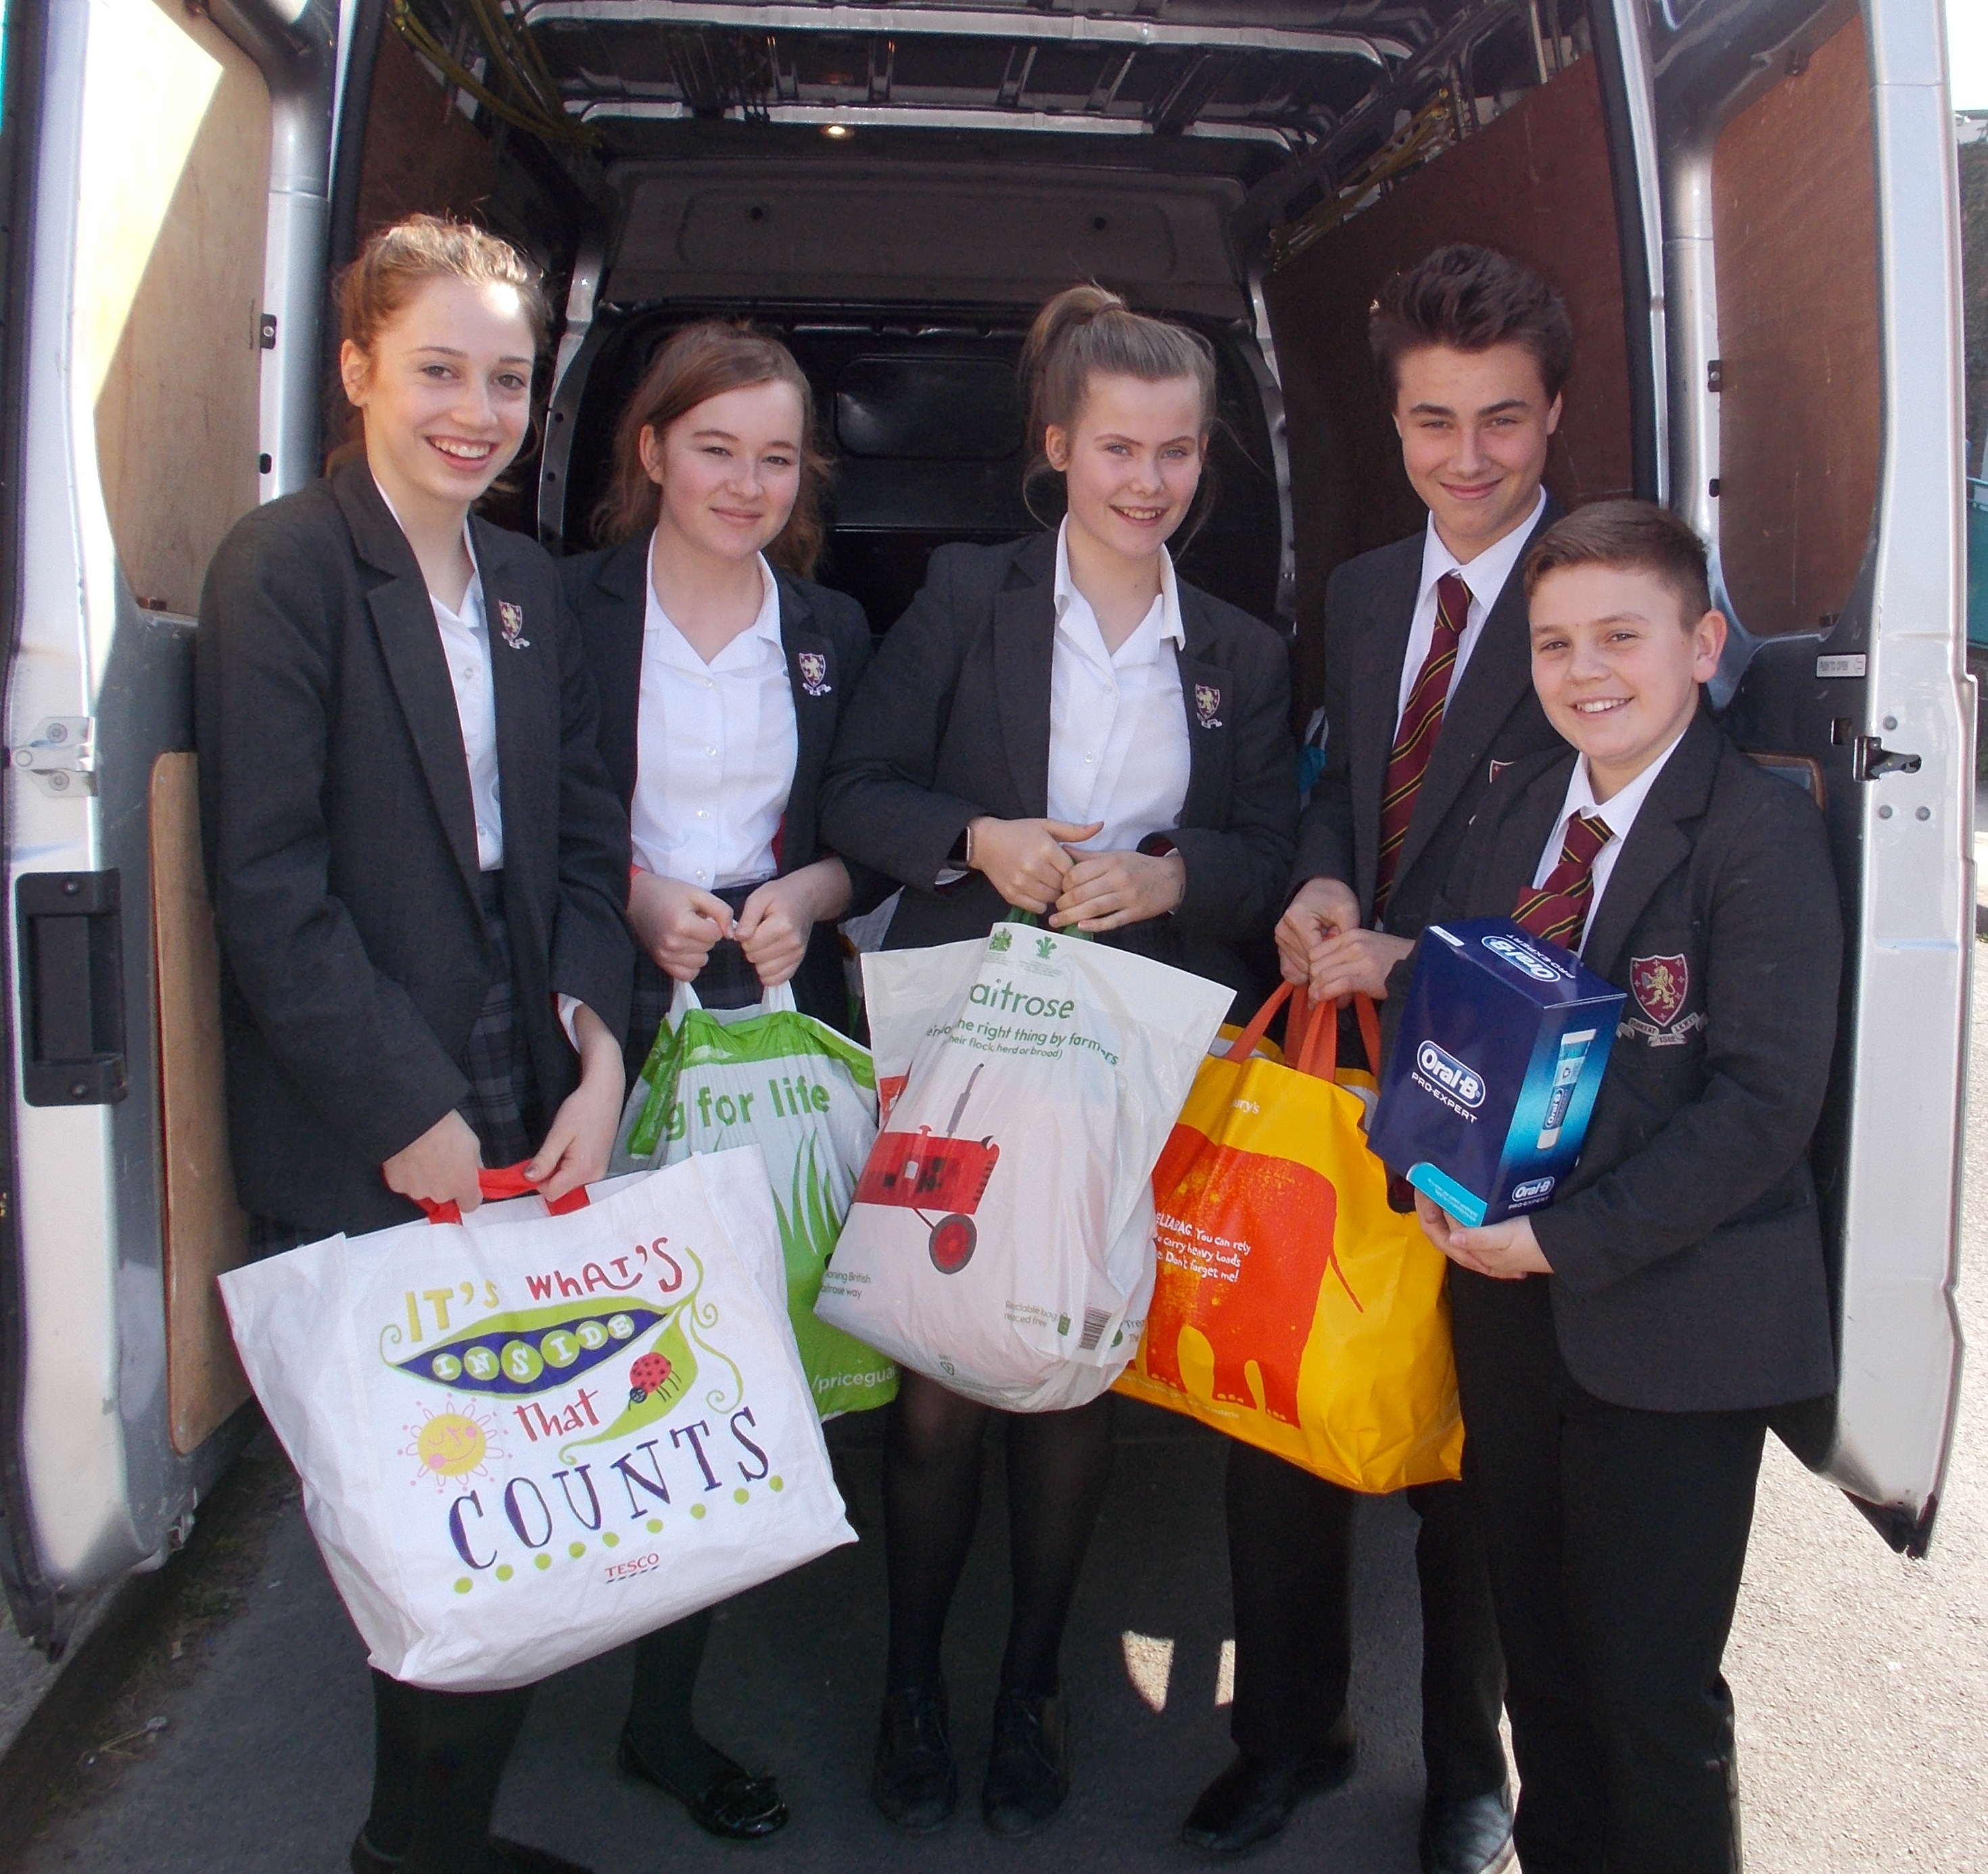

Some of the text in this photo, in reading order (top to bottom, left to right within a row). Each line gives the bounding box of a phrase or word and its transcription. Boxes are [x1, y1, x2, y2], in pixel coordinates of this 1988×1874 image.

[970, 978, 1075, 1018] aitrose
[949, 1035, 967, 1045] heir
[997, 1044, 1019, 1055] herd
[1032, 1047, 1063, 1060] brood)
[977, 1021, 1012, 1041] right
[1014, 1027, 1047, 1046] thing
[1049, 1032, 1066, 1047] by
[1421, 1048, 1479, 1100] Oral-B
[696, 1085, 755, 1127] for
[768, 1075, 831, 1118] life
[1231, 1098, 1260, 1115] ury's
[1163, 1237, 1187, 1253] carry
[1187, 1242, 1214, 1263] heavy
[1196, 1228, 1213, 1243] You
[1214, 1237, 1231, 1248] can
[1233, 1241, 1251, 1256] rely
[849, 1271, 871, 1284] British
[1165, 1250, 1189, 1269] Don't
[1189, 1259, 1218, 1279] forget
[1221, 1269, 1239, 1282] me!
[847, 1288, 863, 1300] way
[405, 1280, 500, 1342] IT'S
[434, 1315, 631, 1378] INSIDE
[448, 1406, 770, 1570] COUNTS
[605, 1553, 660, 1579] TESCO
